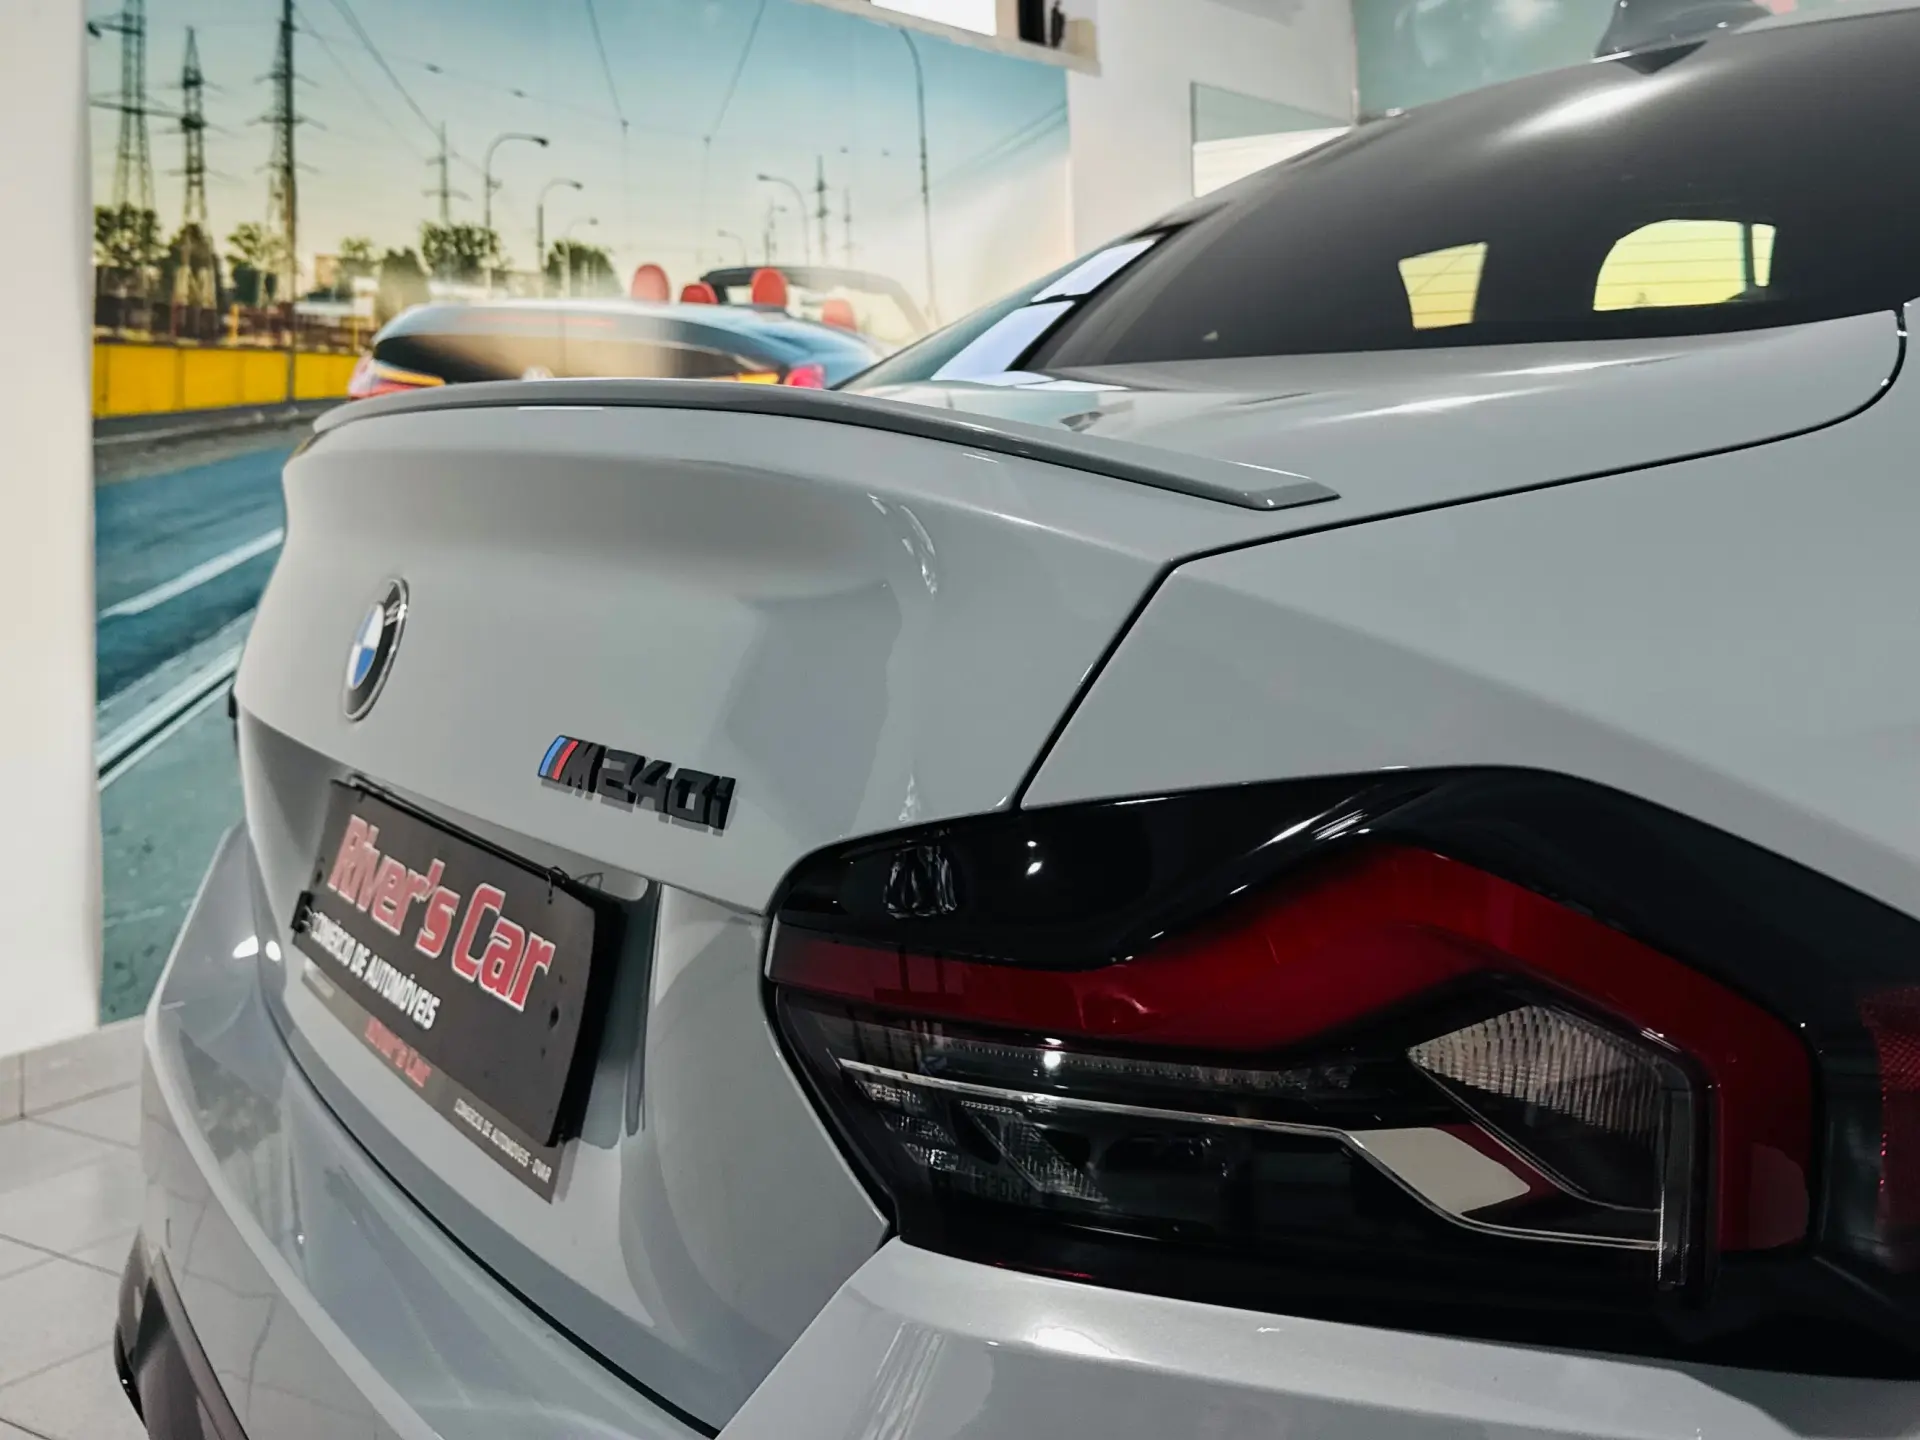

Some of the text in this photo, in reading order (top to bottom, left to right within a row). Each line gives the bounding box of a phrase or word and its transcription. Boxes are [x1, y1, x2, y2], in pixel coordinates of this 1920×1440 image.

[556, 736, 736, 830] M240i
[327, 813, 556, 1012] River's Car
[349, 942, 371, 979] DE
[363, 954, 441, 1030] AUTOMÓVEIS
